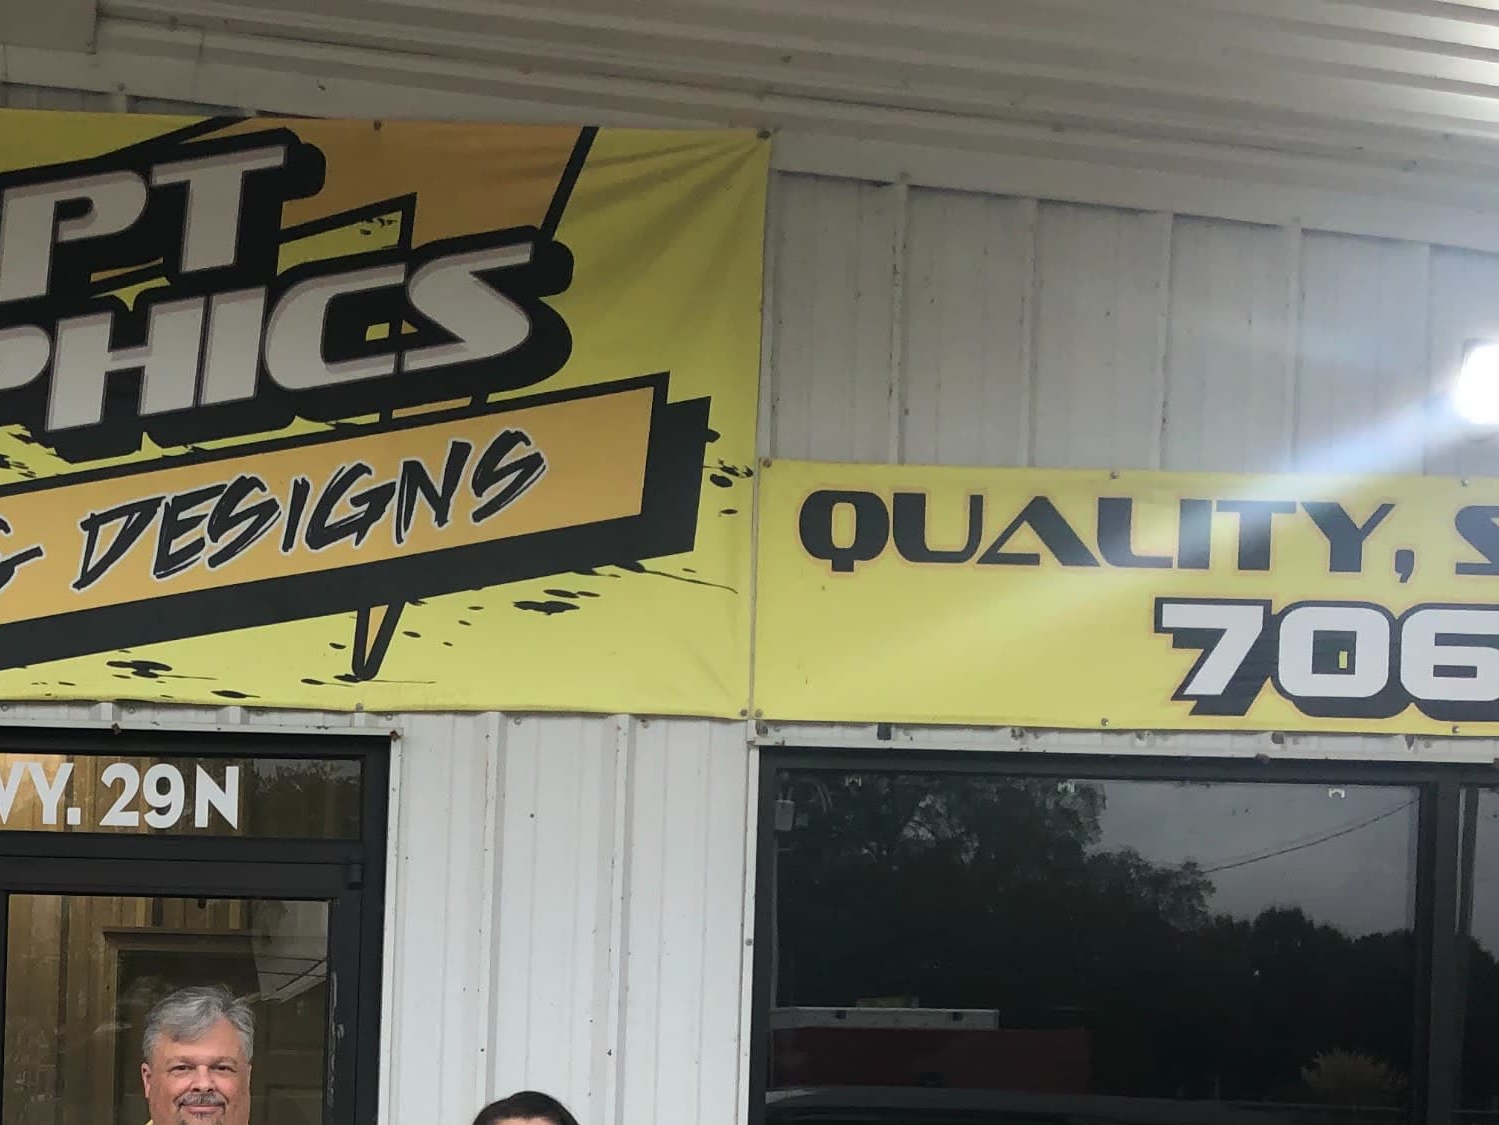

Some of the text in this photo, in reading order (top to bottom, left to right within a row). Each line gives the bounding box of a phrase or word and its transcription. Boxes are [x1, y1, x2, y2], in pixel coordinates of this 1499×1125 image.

[71, 429, 547, 592] DESIGNS
[799, 490, 1415, 583] QUALITY,
[1157, 599, 1499, 706] 706
[99, 762, 241, 831] 29N
